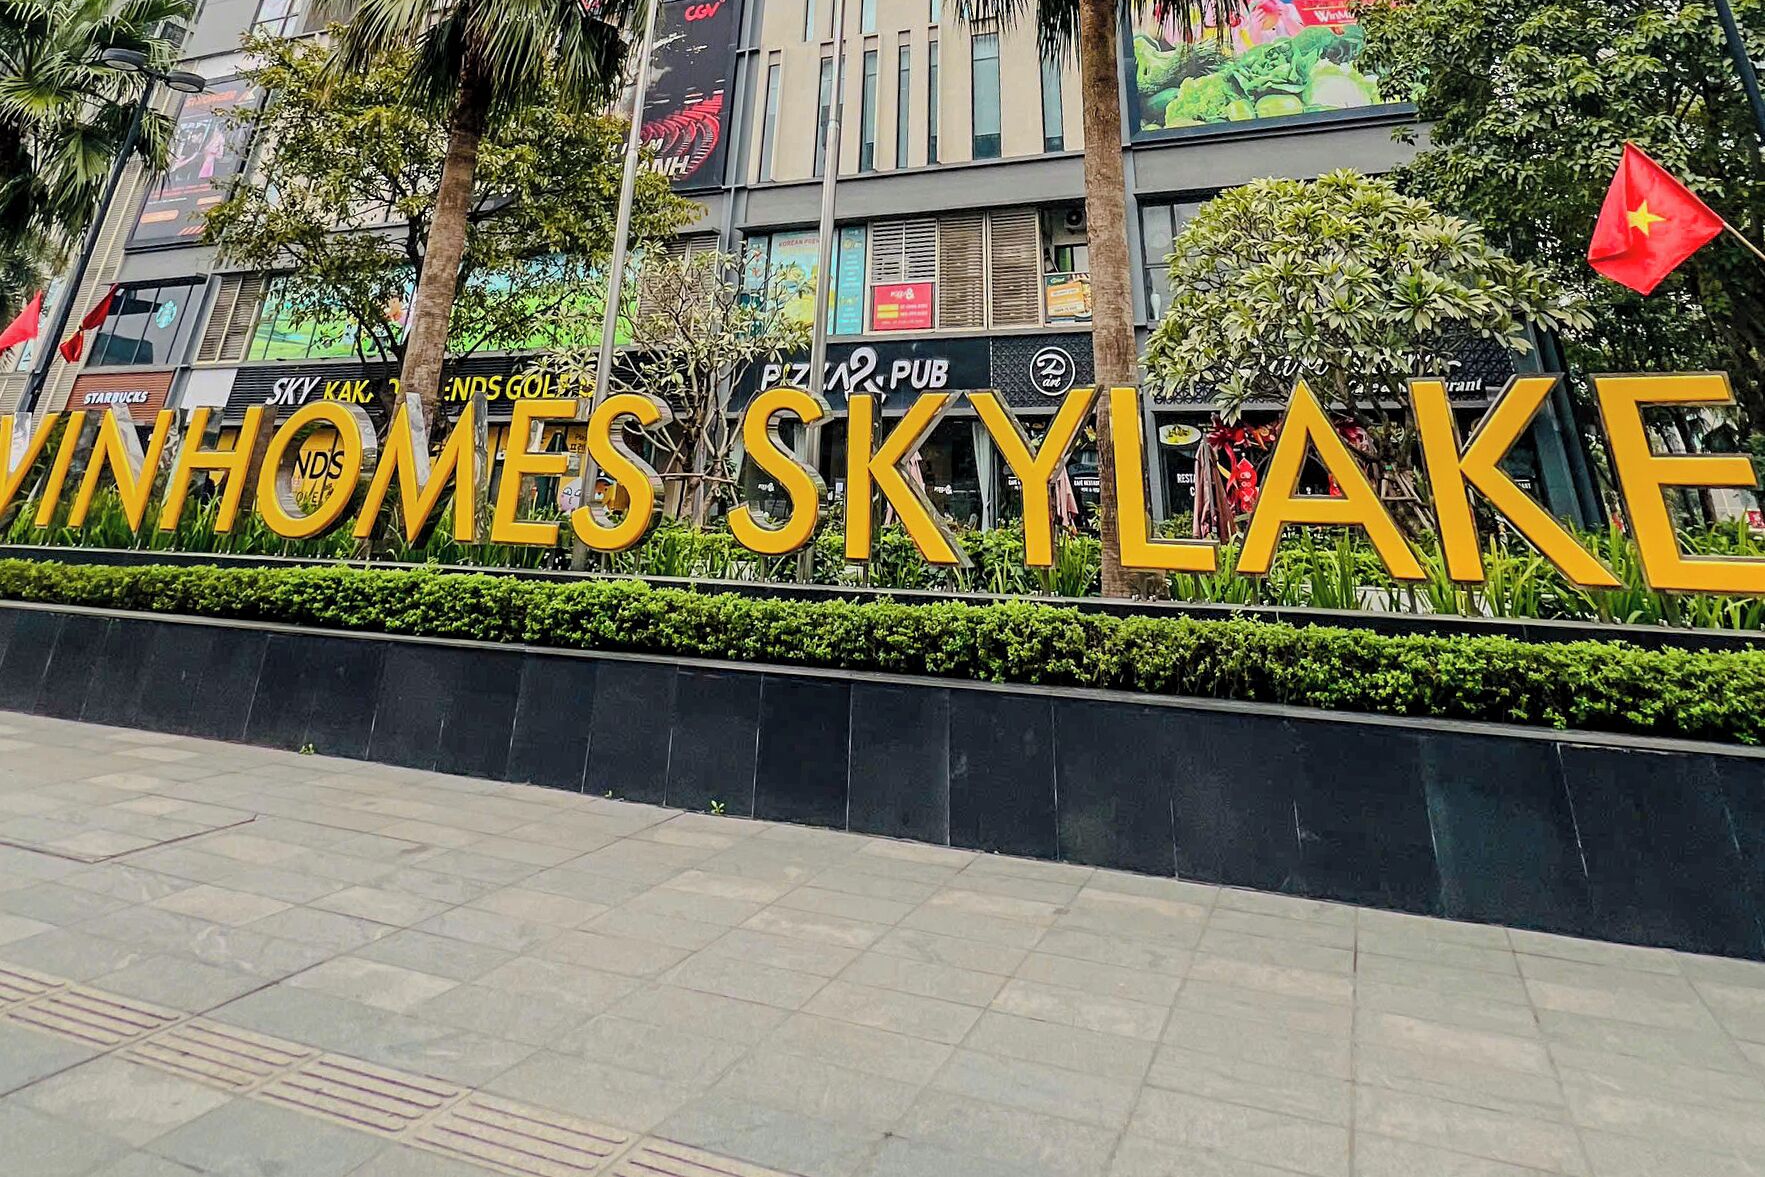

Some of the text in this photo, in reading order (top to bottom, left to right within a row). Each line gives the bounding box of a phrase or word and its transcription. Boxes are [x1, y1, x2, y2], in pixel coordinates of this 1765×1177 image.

[684, 1, 720, 23] CGV
[889, 360, 950, 389] PUB
[83, 390, 150, 405] STARBUCKS
[264, 376, 323, 405] SKY
[323, 379, 400, 404] KAK
[0, 375, 1765, 592] VINHOMES SKYLAKE
